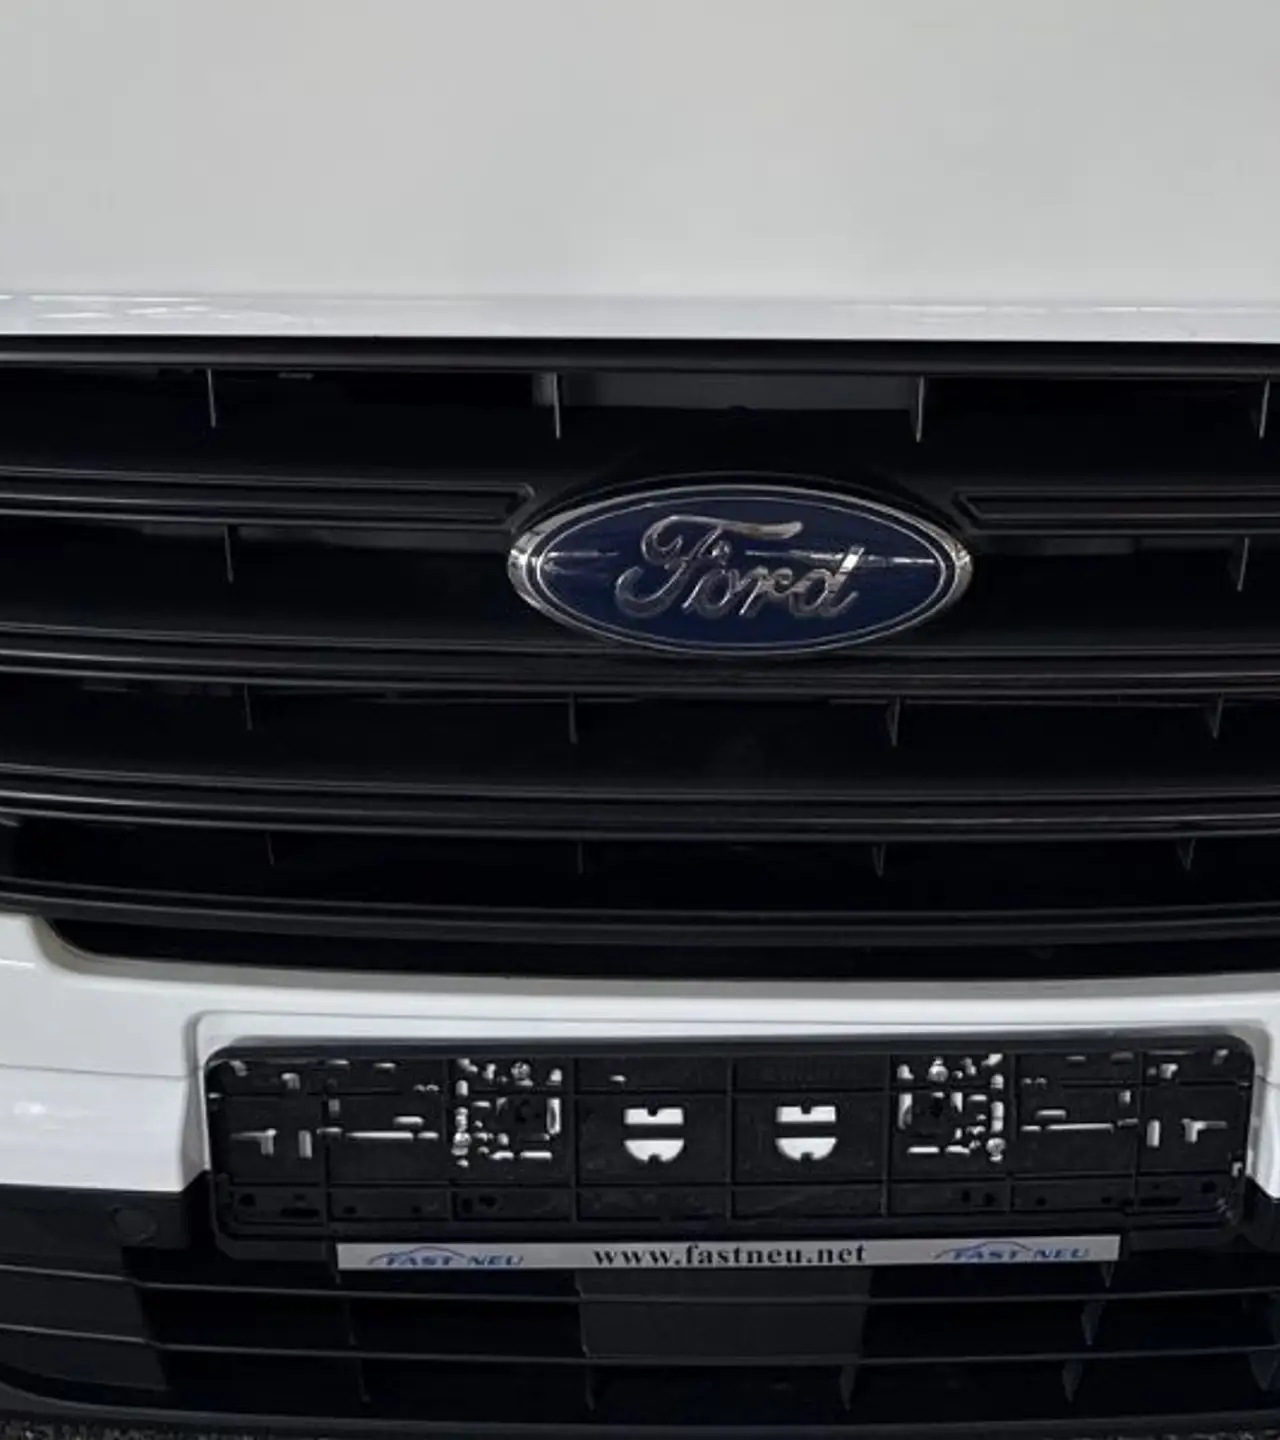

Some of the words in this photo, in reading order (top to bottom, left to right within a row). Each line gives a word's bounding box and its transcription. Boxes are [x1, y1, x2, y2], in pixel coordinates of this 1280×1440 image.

[616, 515, 865, 618] Ford
[382, 1254, 453, 1267] FAST
[468, 1254, 524, 1267] NEU
[593, 1242, 868, 1266] www.fastneu.net
[952, 1247, 1019, 1261] FAST
[1033, 1246, 1089, 1260] NEU
